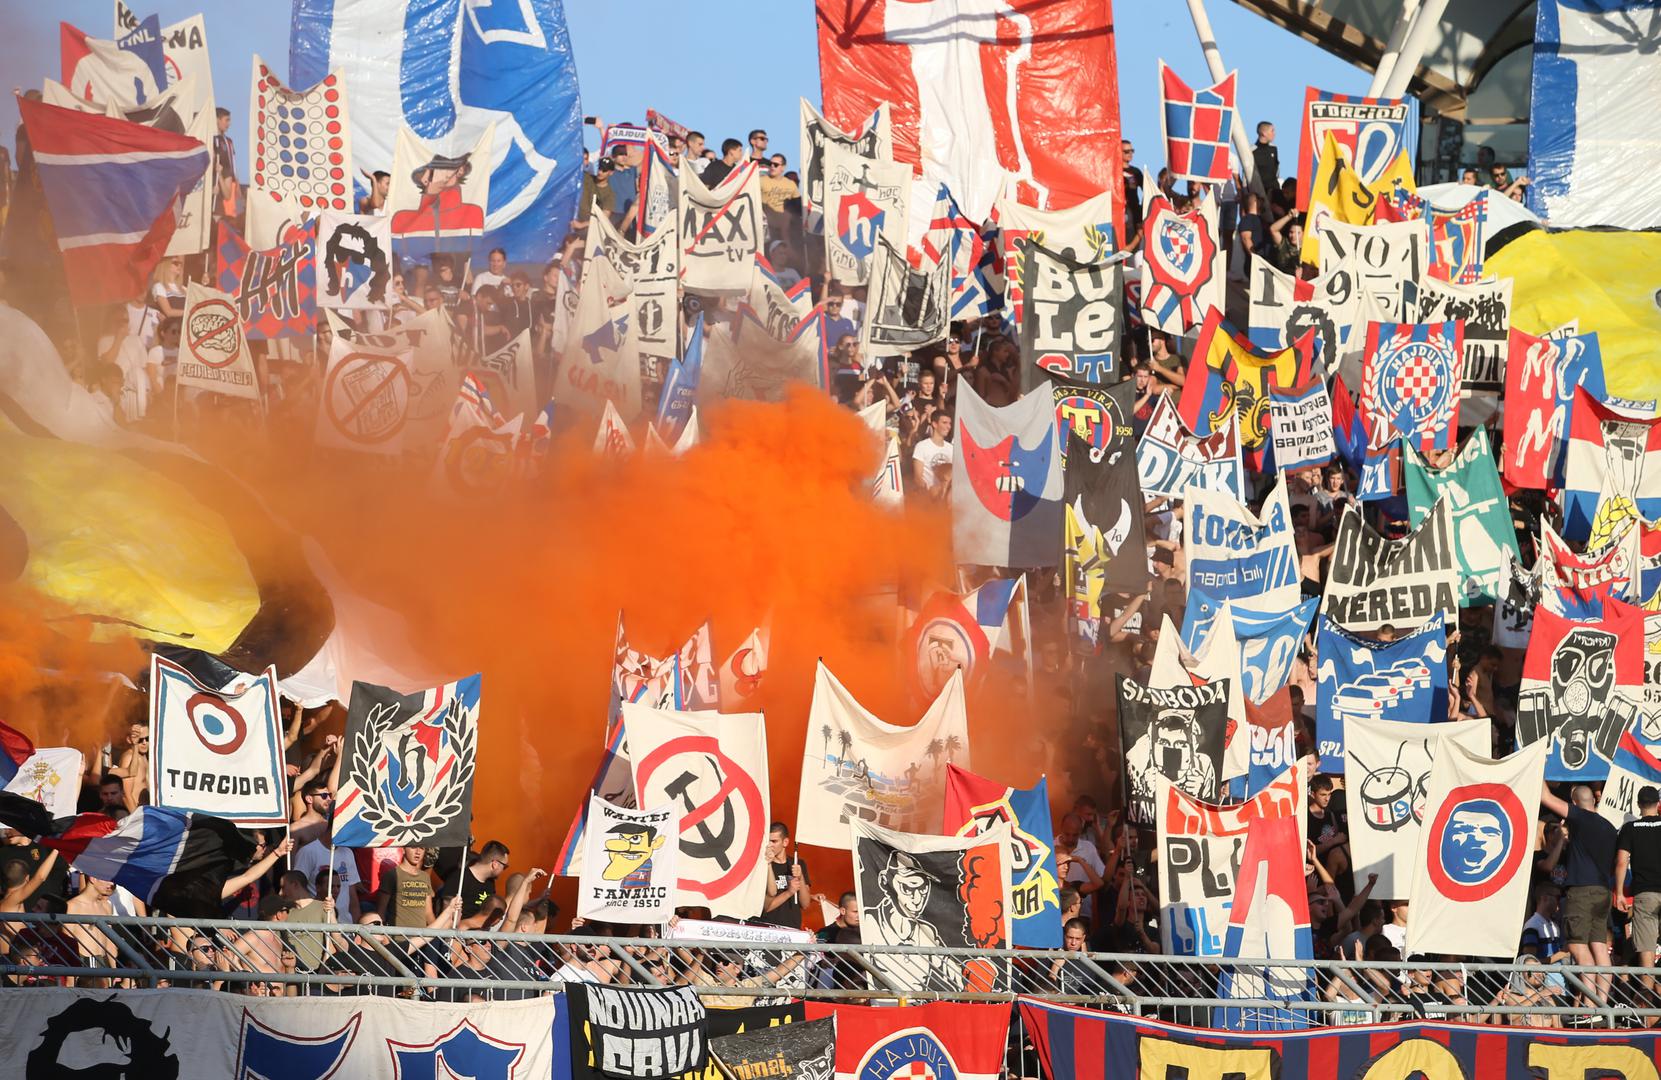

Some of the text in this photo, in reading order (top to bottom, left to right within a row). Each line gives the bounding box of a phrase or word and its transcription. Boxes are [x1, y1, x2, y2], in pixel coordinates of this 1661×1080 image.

[726, 245, 744, 263] tv
[1391, 345, 1443, 371] HAJDUK
[1115, 425, 1134, 437] 1950
[1325, 581, 1458, 626] NEREDA
[1122, 676, 1227, 710] SLOBODA
[1318, 740, 1345, 759] SPL
[166, 768, 270, 795] TORCIDA
[593, 886, 667, 900] FANATIC
[605, 898, 661, 908] since 1950
[868, 1037, 949, 1079] HAJDUK
